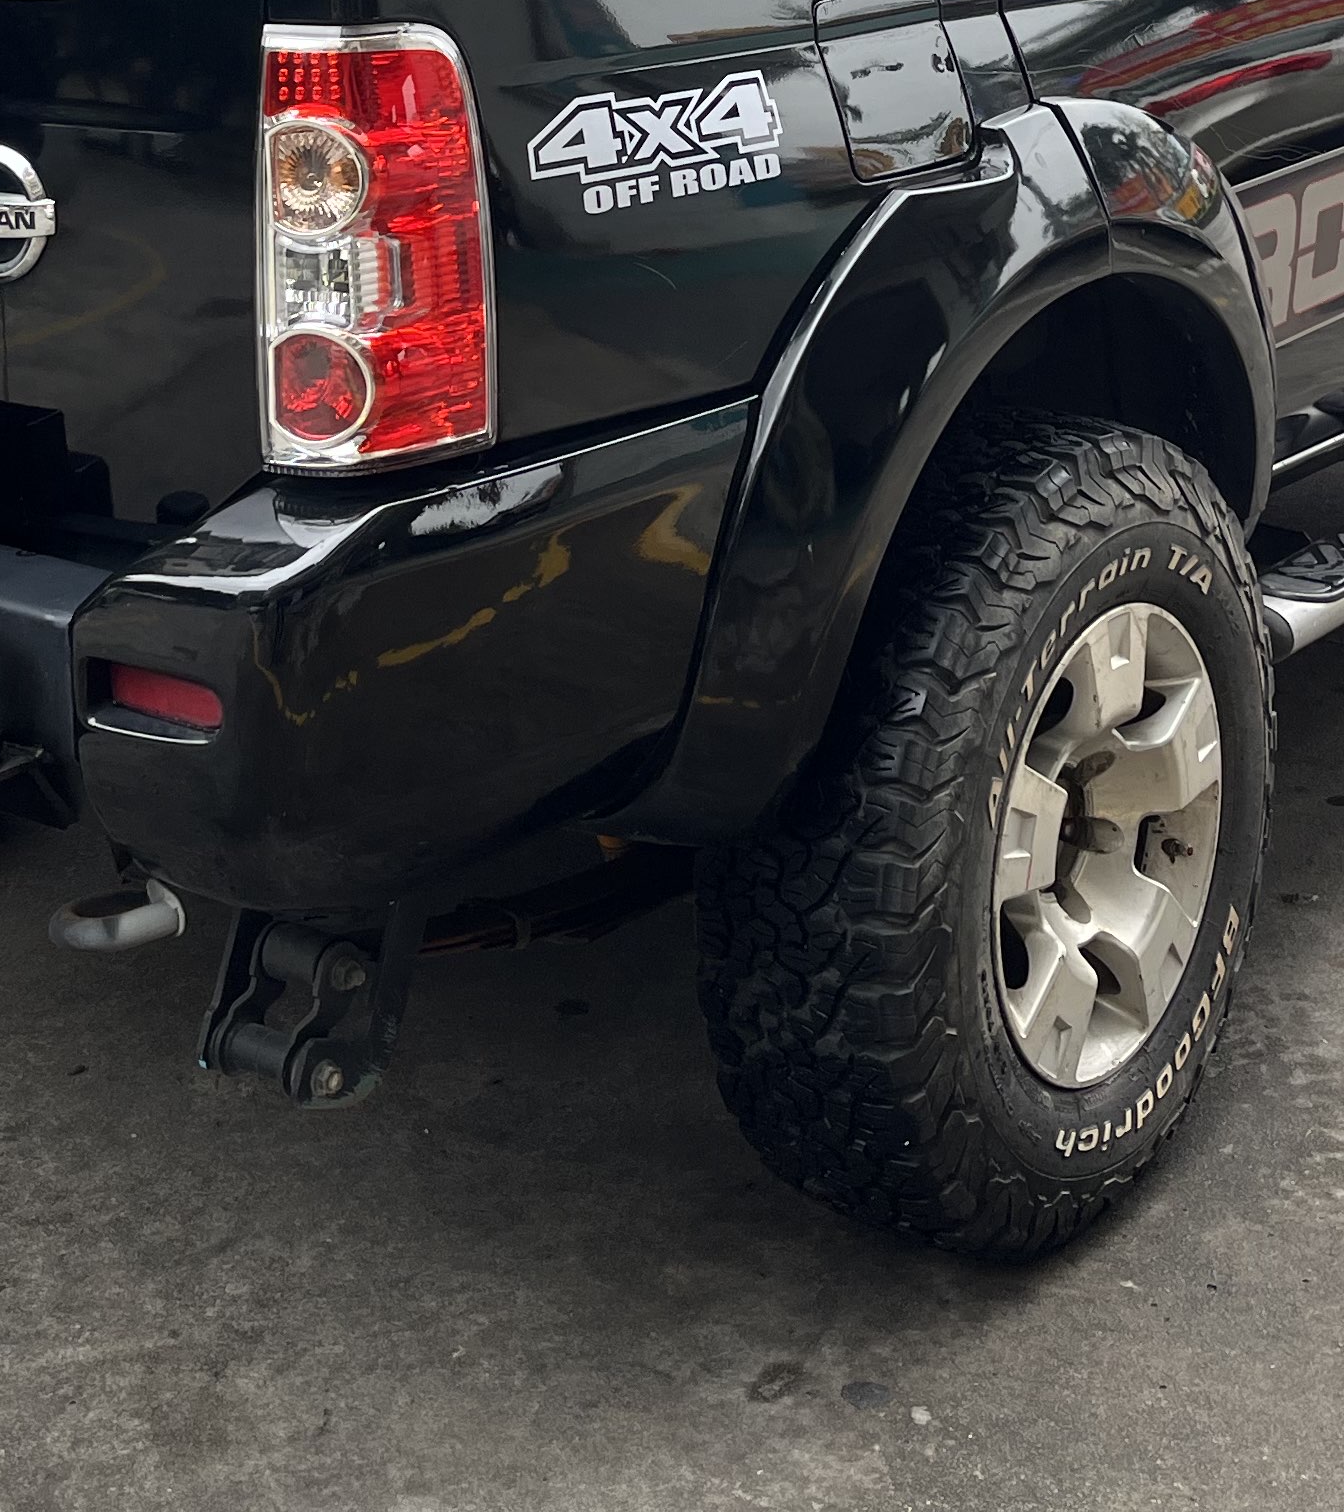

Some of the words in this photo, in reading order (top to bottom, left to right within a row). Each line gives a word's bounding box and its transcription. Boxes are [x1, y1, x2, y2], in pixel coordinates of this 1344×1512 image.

[582, 174, 660, 215] OFF
[669, 152, 782, 198] ROAD
[1166, 542, 1214, 596] T/A
[1055, 903, 1240, 1159] BFGoodrich
